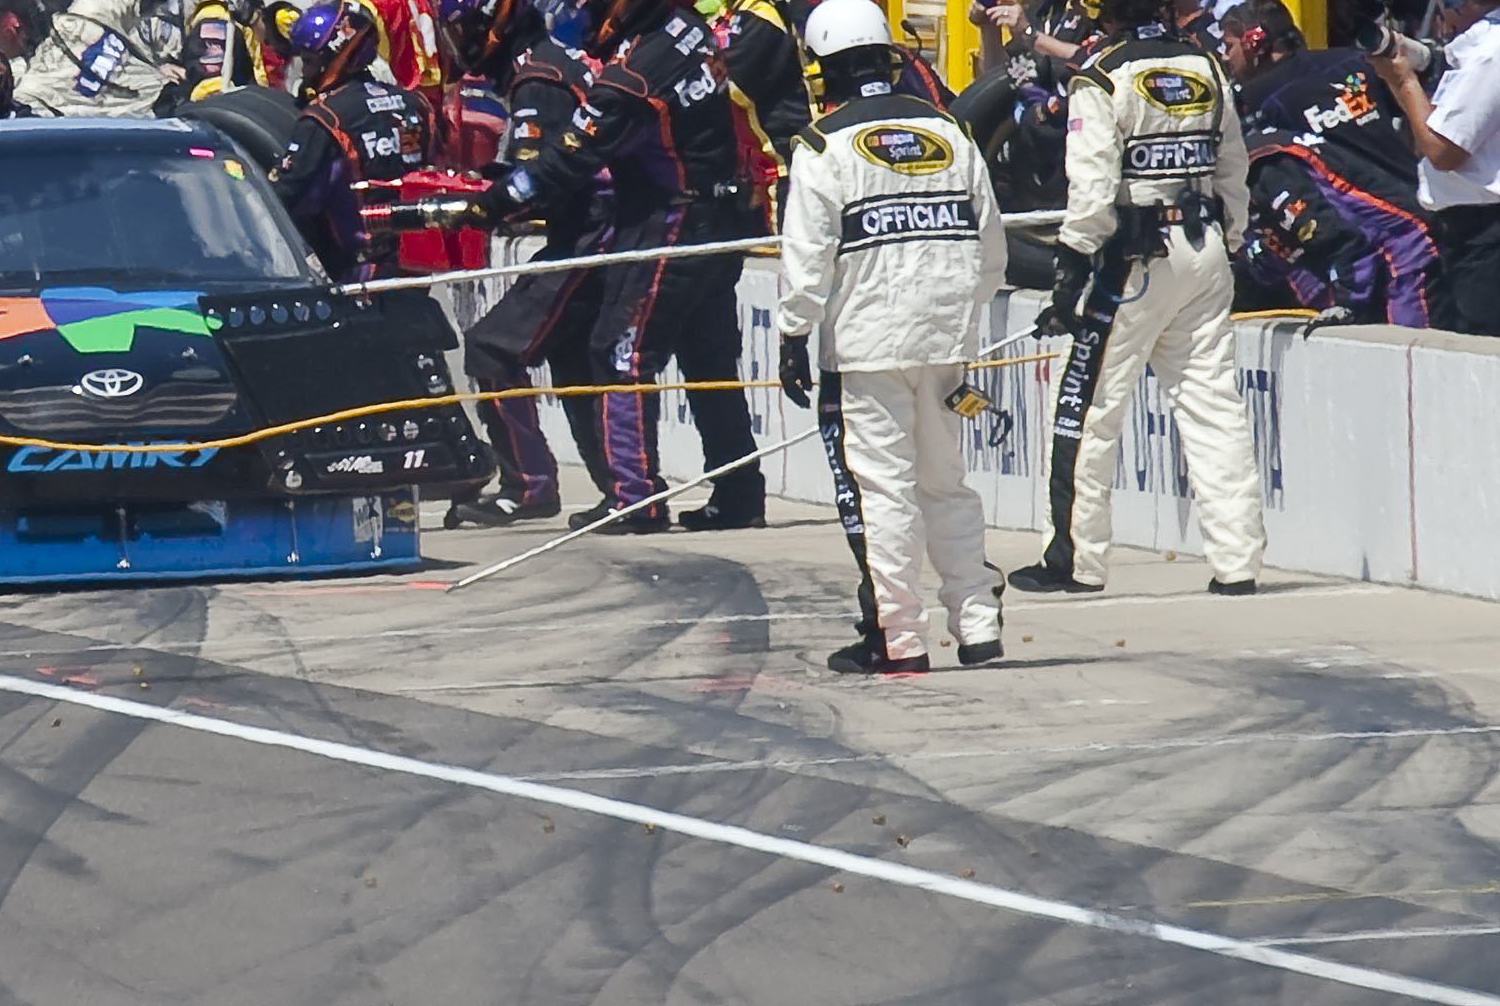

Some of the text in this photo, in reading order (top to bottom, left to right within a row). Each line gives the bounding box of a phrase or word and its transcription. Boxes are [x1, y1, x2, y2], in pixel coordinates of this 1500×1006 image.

[888, 144, 923, 160] Sprint
[862, 203, 969, 234] OFFICIAL
[7, 440, 220, 472] CAMRY
